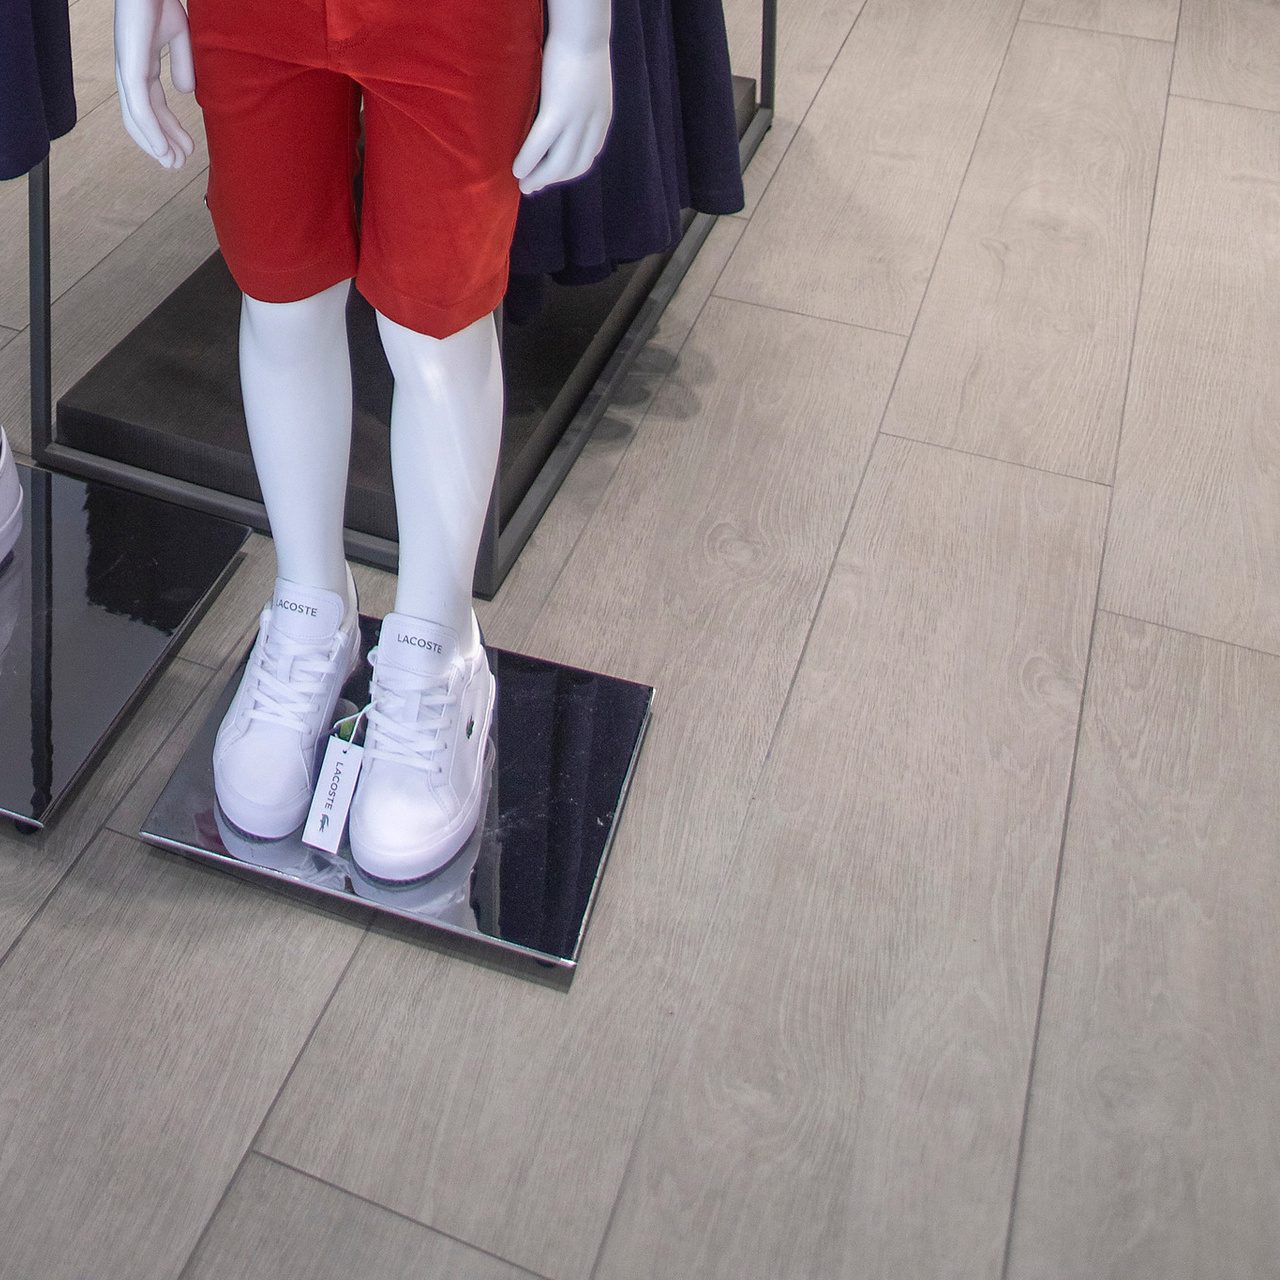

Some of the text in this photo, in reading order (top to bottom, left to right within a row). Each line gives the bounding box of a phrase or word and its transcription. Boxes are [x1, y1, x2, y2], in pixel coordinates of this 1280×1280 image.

[275, 598, 318, 617] LACOSTE
[397, 633, 443, 655] LACOSTE
[324, 761, 344, 811] LACOSTE
